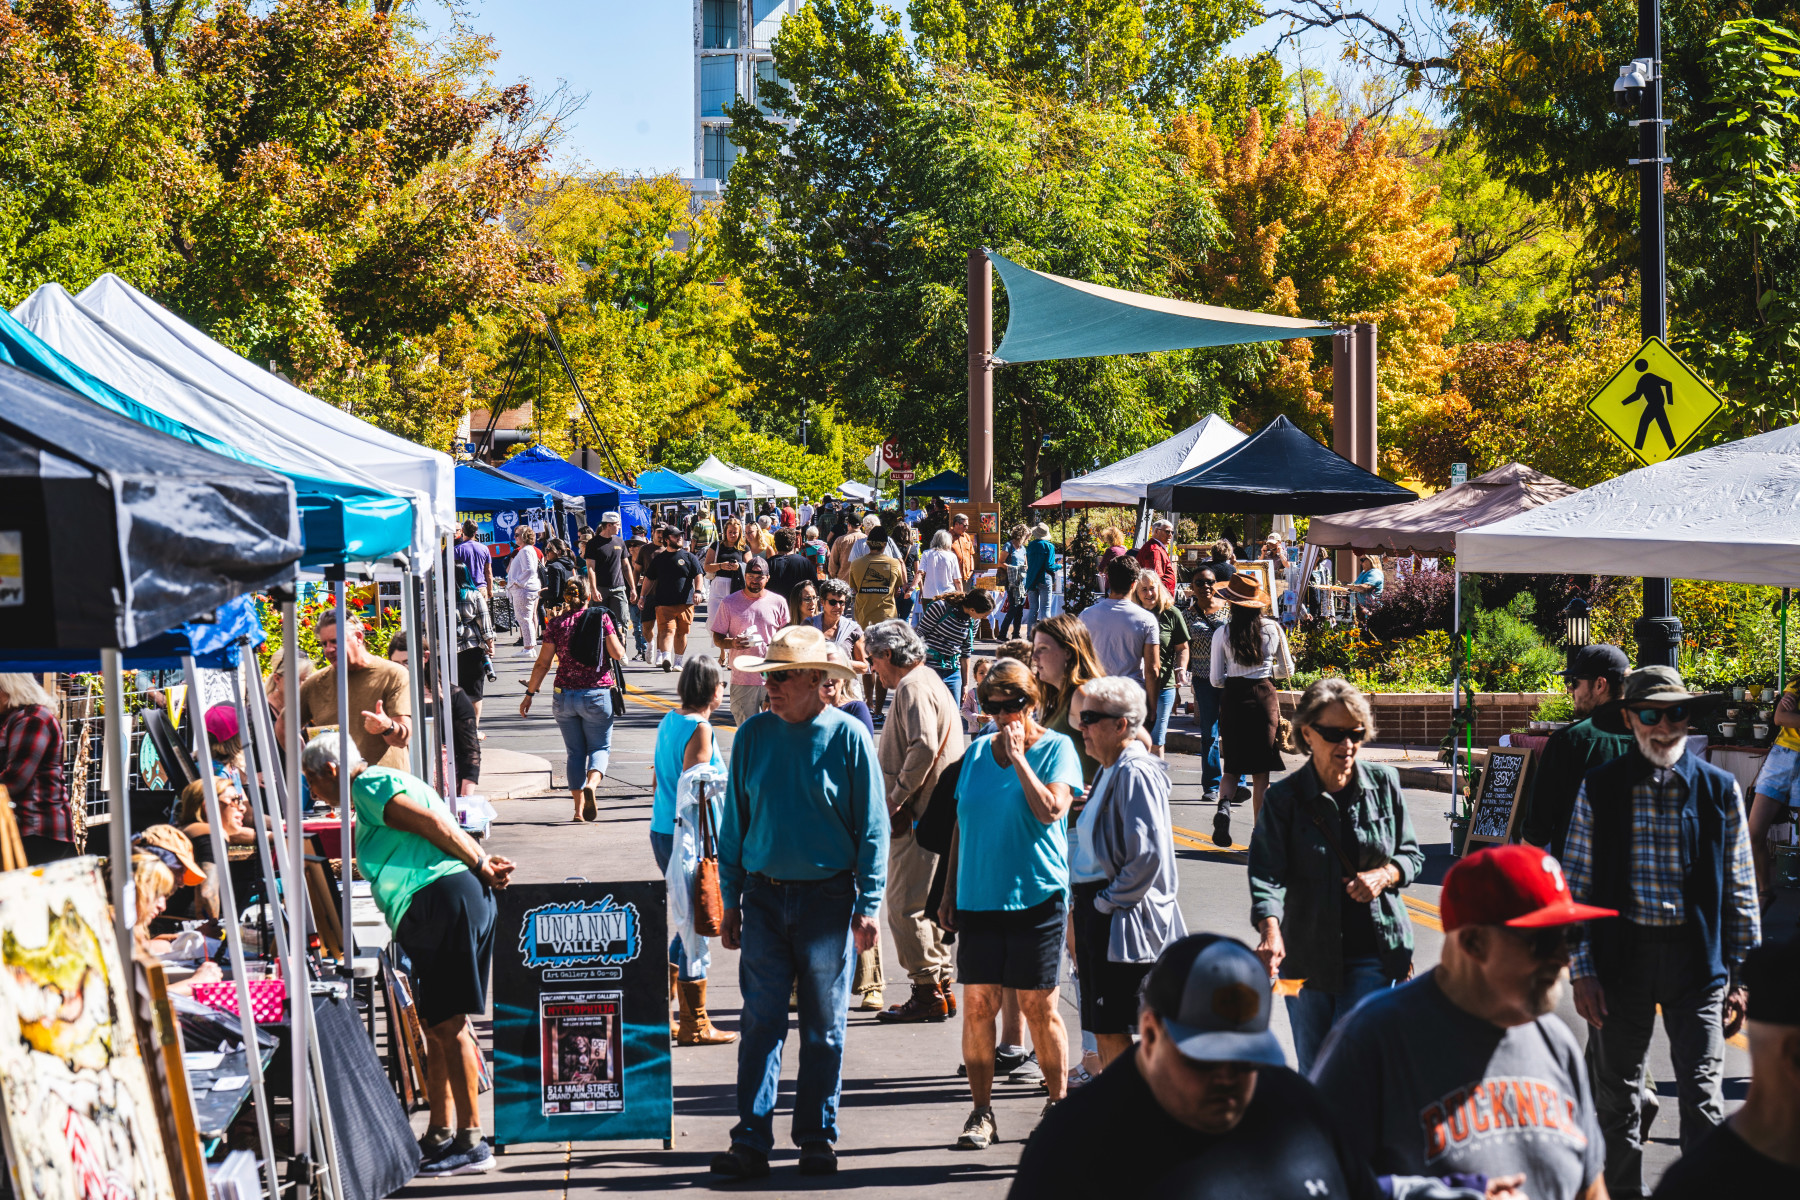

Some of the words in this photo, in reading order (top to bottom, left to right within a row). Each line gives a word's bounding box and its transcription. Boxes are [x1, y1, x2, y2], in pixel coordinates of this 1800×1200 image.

[1493, 771, 1514, 787] SOY
[541, 913, 623, 942] UNCANNY
[552, 941, 611, 954] VALLEY
[560, 971, 588, 979] Gallery
[597, 969, 618, 978] Co-op
[547, 1004, 615, 1016] NYCTOPHILIA
[592, 1040, 606, 1048] OCT
[594, 1048, 600, 1057] 6
[547, 1085, 562, 1094] 514
[564, 1084, 585, 1093] MAIN
[586, 1083, 619, 1092] STREET
